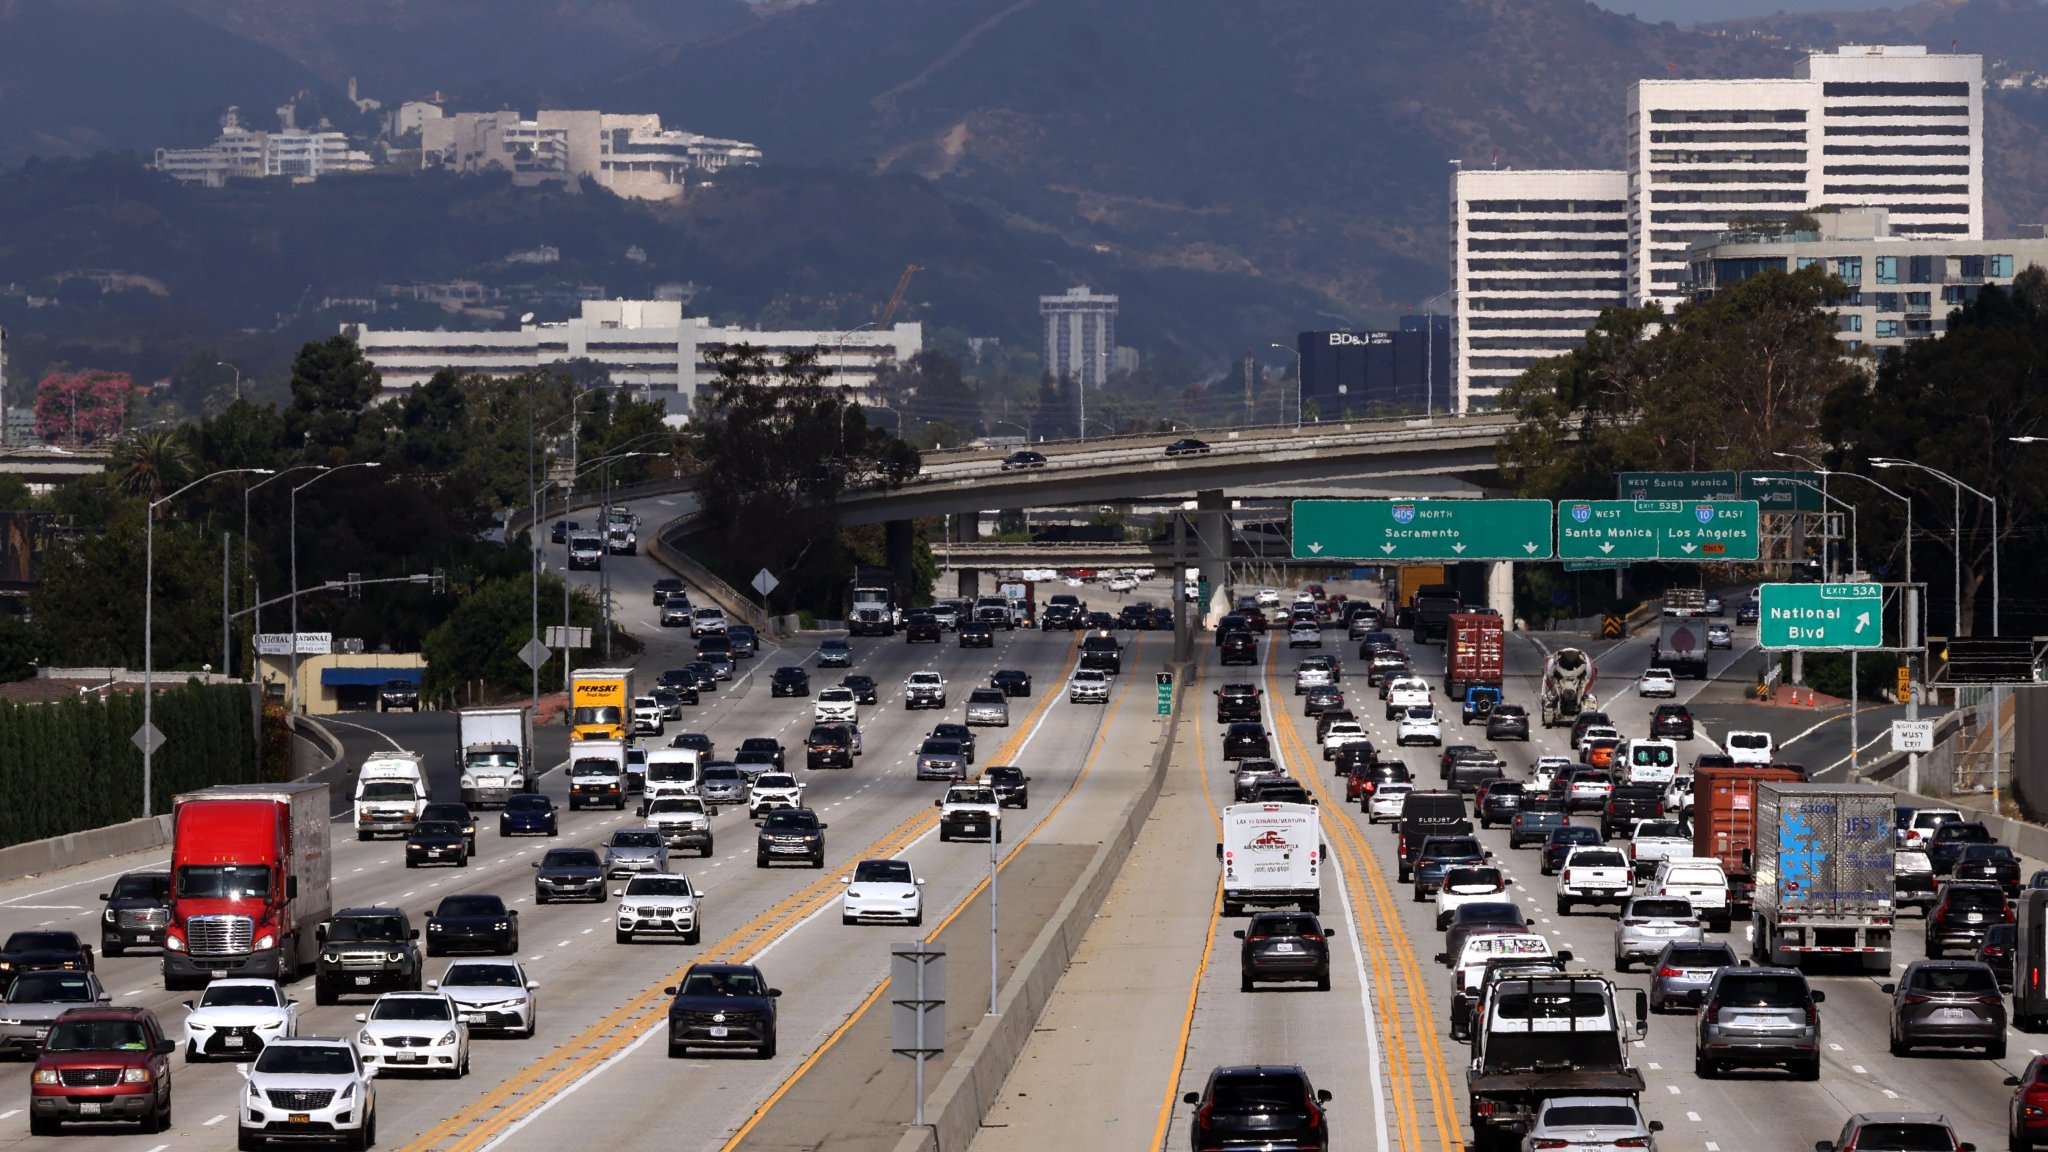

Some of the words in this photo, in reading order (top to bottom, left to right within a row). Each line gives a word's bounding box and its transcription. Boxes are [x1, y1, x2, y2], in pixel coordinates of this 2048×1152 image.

[1329, 333, 1369, 345] BD&J
[1653, 479, 1684, 488] Santa
[1691, 478, 1728, 487] Monica
[1659, 502, 1678, 510] 53B
[1394, 510, 1413, 520] 405
[1419, 510, 1453, 519] NORTH
[1576, 510, 1588, 519] 10
[1595, 510, 1622, 518] WEST
[1699, 510, 1710, 520] 10
[1718, 510, 1744, 518] EAST
[1385, 528, 1460, 538] Sacramento
[1565, 528, 1602, 537] Santa
[1607, 527, 1652, 537] Monica
[1668, 528, 1691, 537] Los
[1697, 528, 1747, 540] Angeles
[1702, 544, 1725, 553] ONLY
[1826, 587, 1847, 595] EXIT
[1852, 586, 1877, 595] 53A
[1771, 607, 1840, 619] National
[1789, 626, 1825, 639] Blvd
